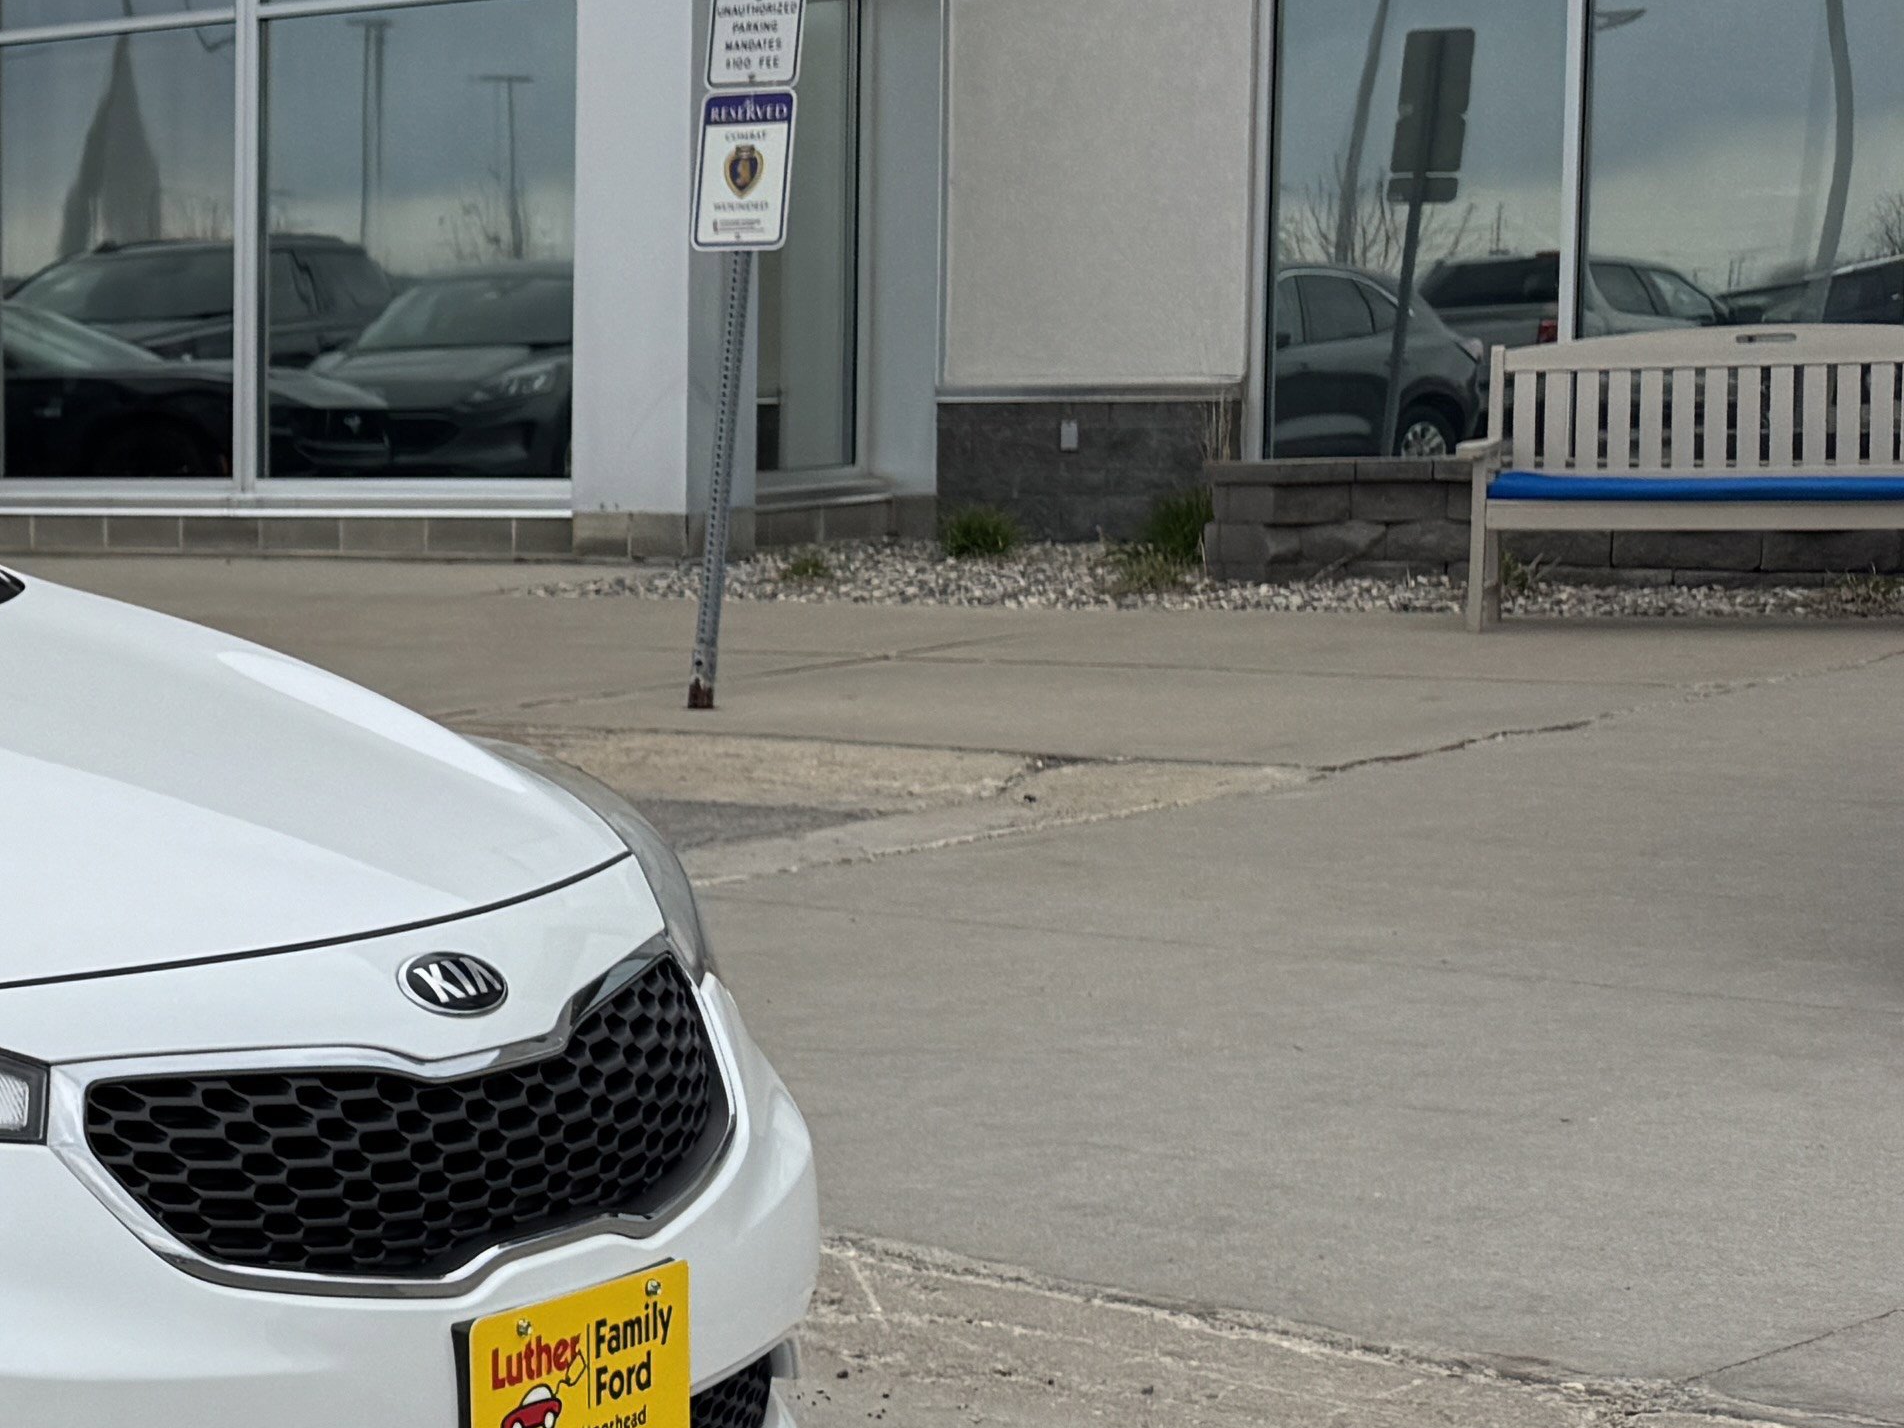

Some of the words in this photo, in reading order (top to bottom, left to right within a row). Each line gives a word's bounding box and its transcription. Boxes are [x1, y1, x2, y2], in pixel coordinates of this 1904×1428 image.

[711, 103, 788, 122] RESERVED
[413, 957, 502, 1003] KIA
[595, 1301, 673, 1359] Family
[492, 1333, 582, 1391] Luther
[595, 1350, 652, 1406] Ford
